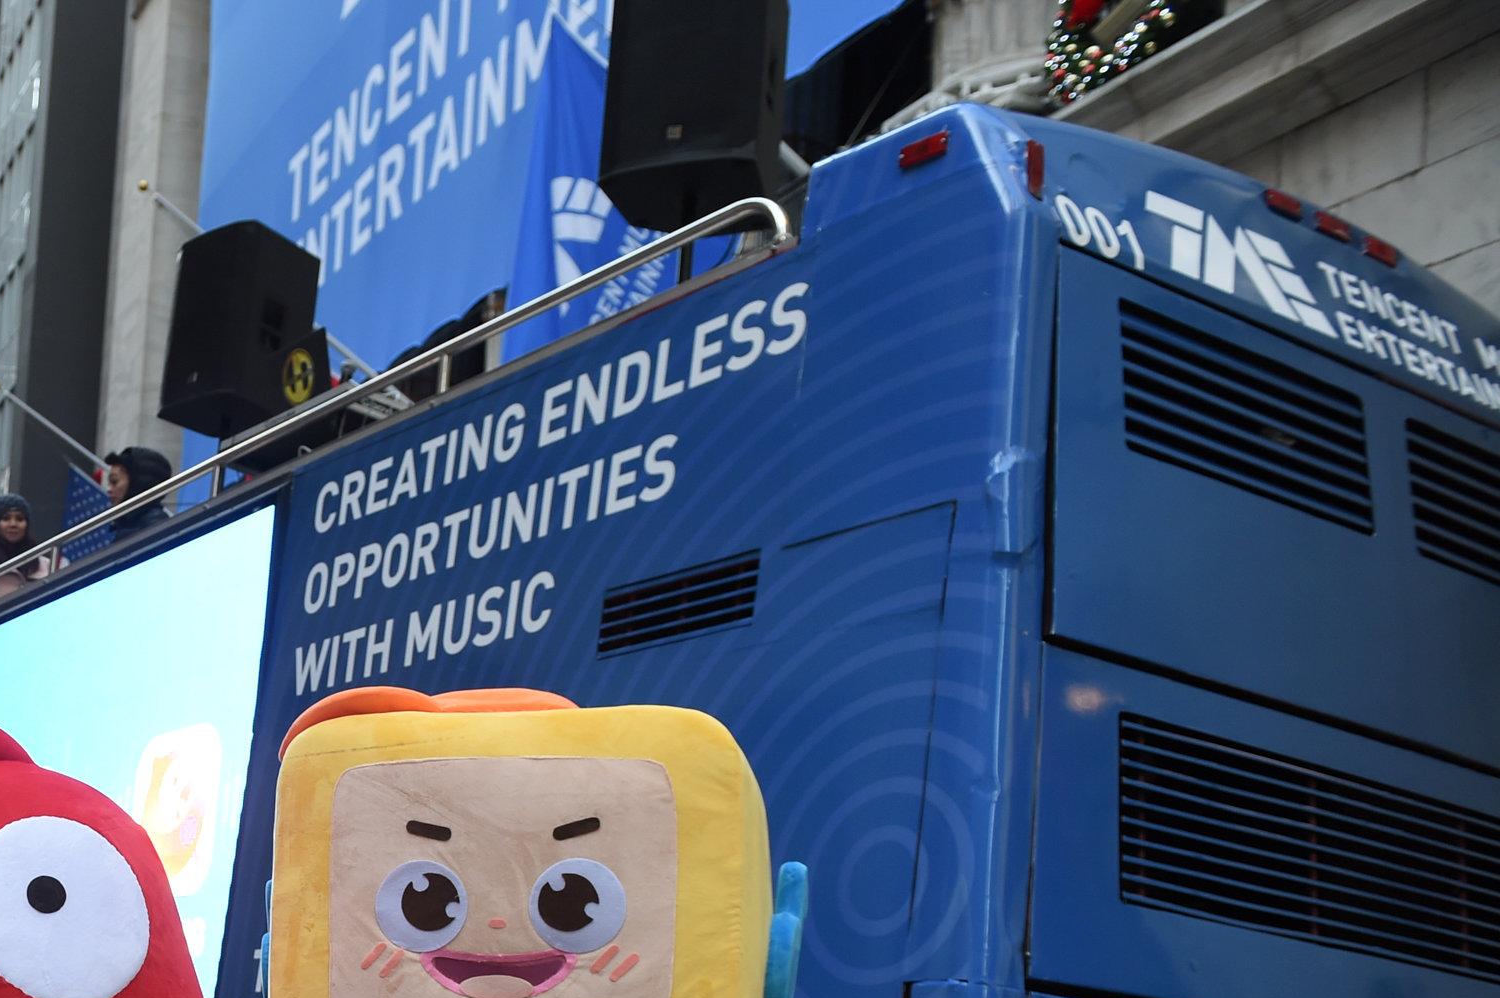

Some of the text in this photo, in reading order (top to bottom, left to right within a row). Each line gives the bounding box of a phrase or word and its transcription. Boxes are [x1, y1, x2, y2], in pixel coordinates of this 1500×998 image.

[288, 0, 470, 223] TENCENT
[1055, 194, 1146, 271] 001
[1316, 261, 1462, 355] TENCENT
[314, 282, 810, 534] CREATING ENDLESS
[303, 433, 679, 615] OPPORTUNITIES
[294, 570, 556, 697] WITH MUSIC
